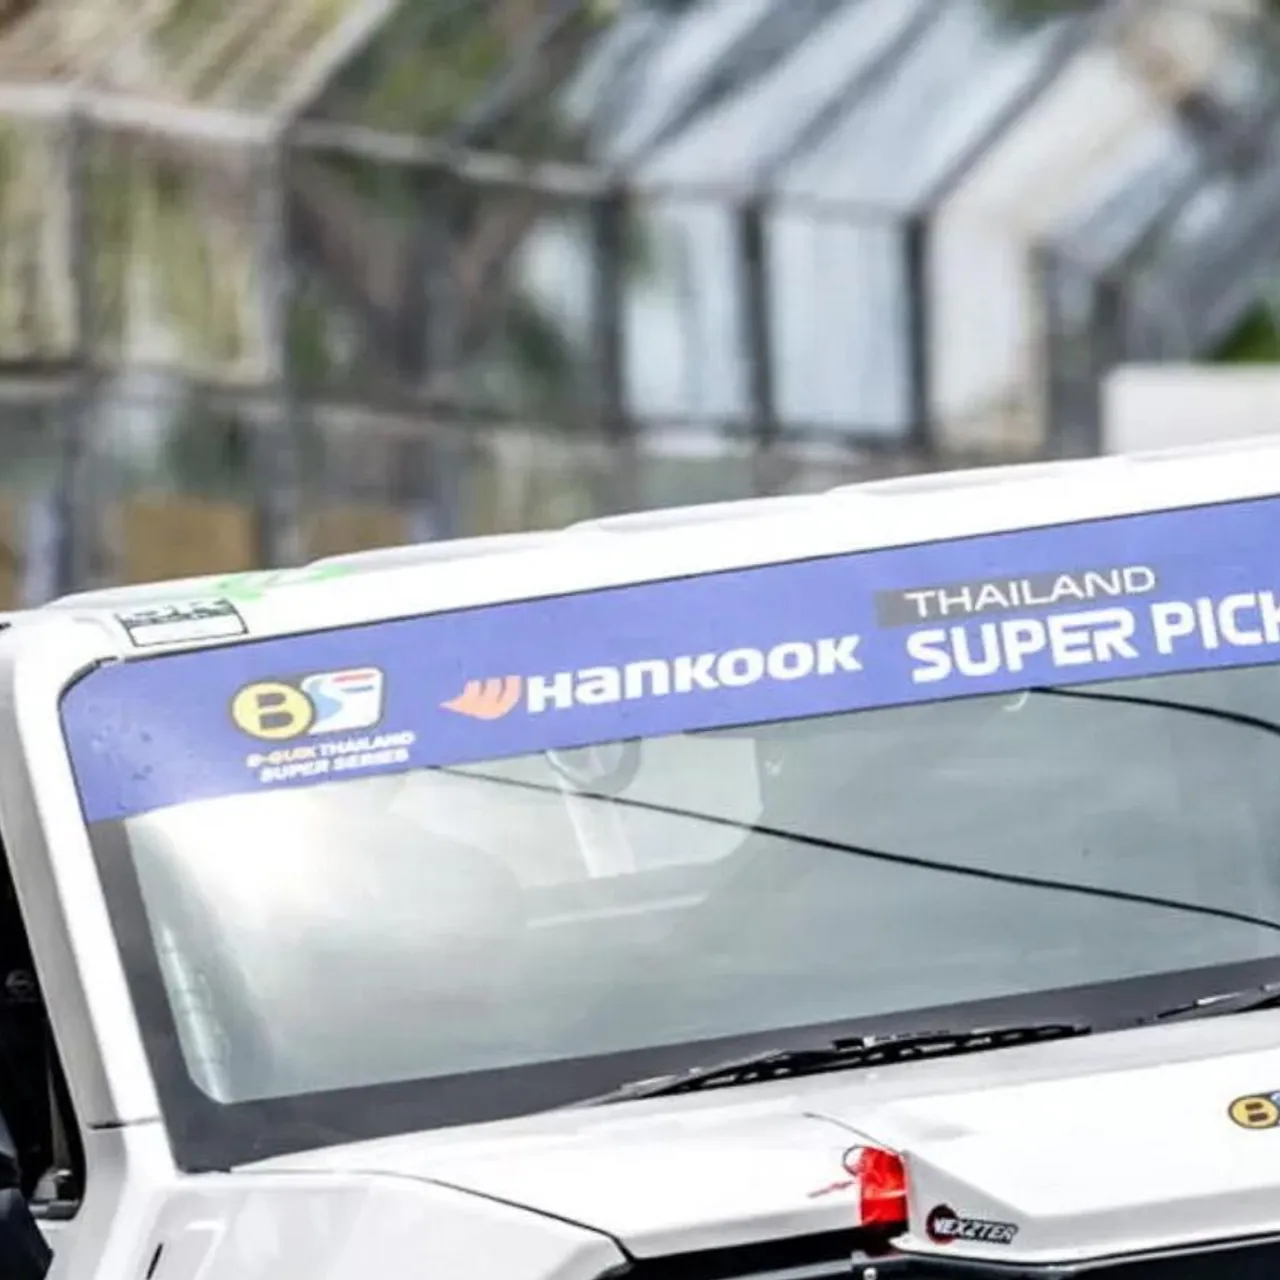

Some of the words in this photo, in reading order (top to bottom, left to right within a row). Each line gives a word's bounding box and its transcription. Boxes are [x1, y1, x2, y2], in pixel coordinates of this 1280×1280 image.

[904, 565, 1156, 618] THAILAND
[906, 606, 1140, 684] SUPER
[258, 758, 330, 784] SUPER
[332, 747, 410, 772] SERIES
[318, 730, 417, 756] THAILAND
